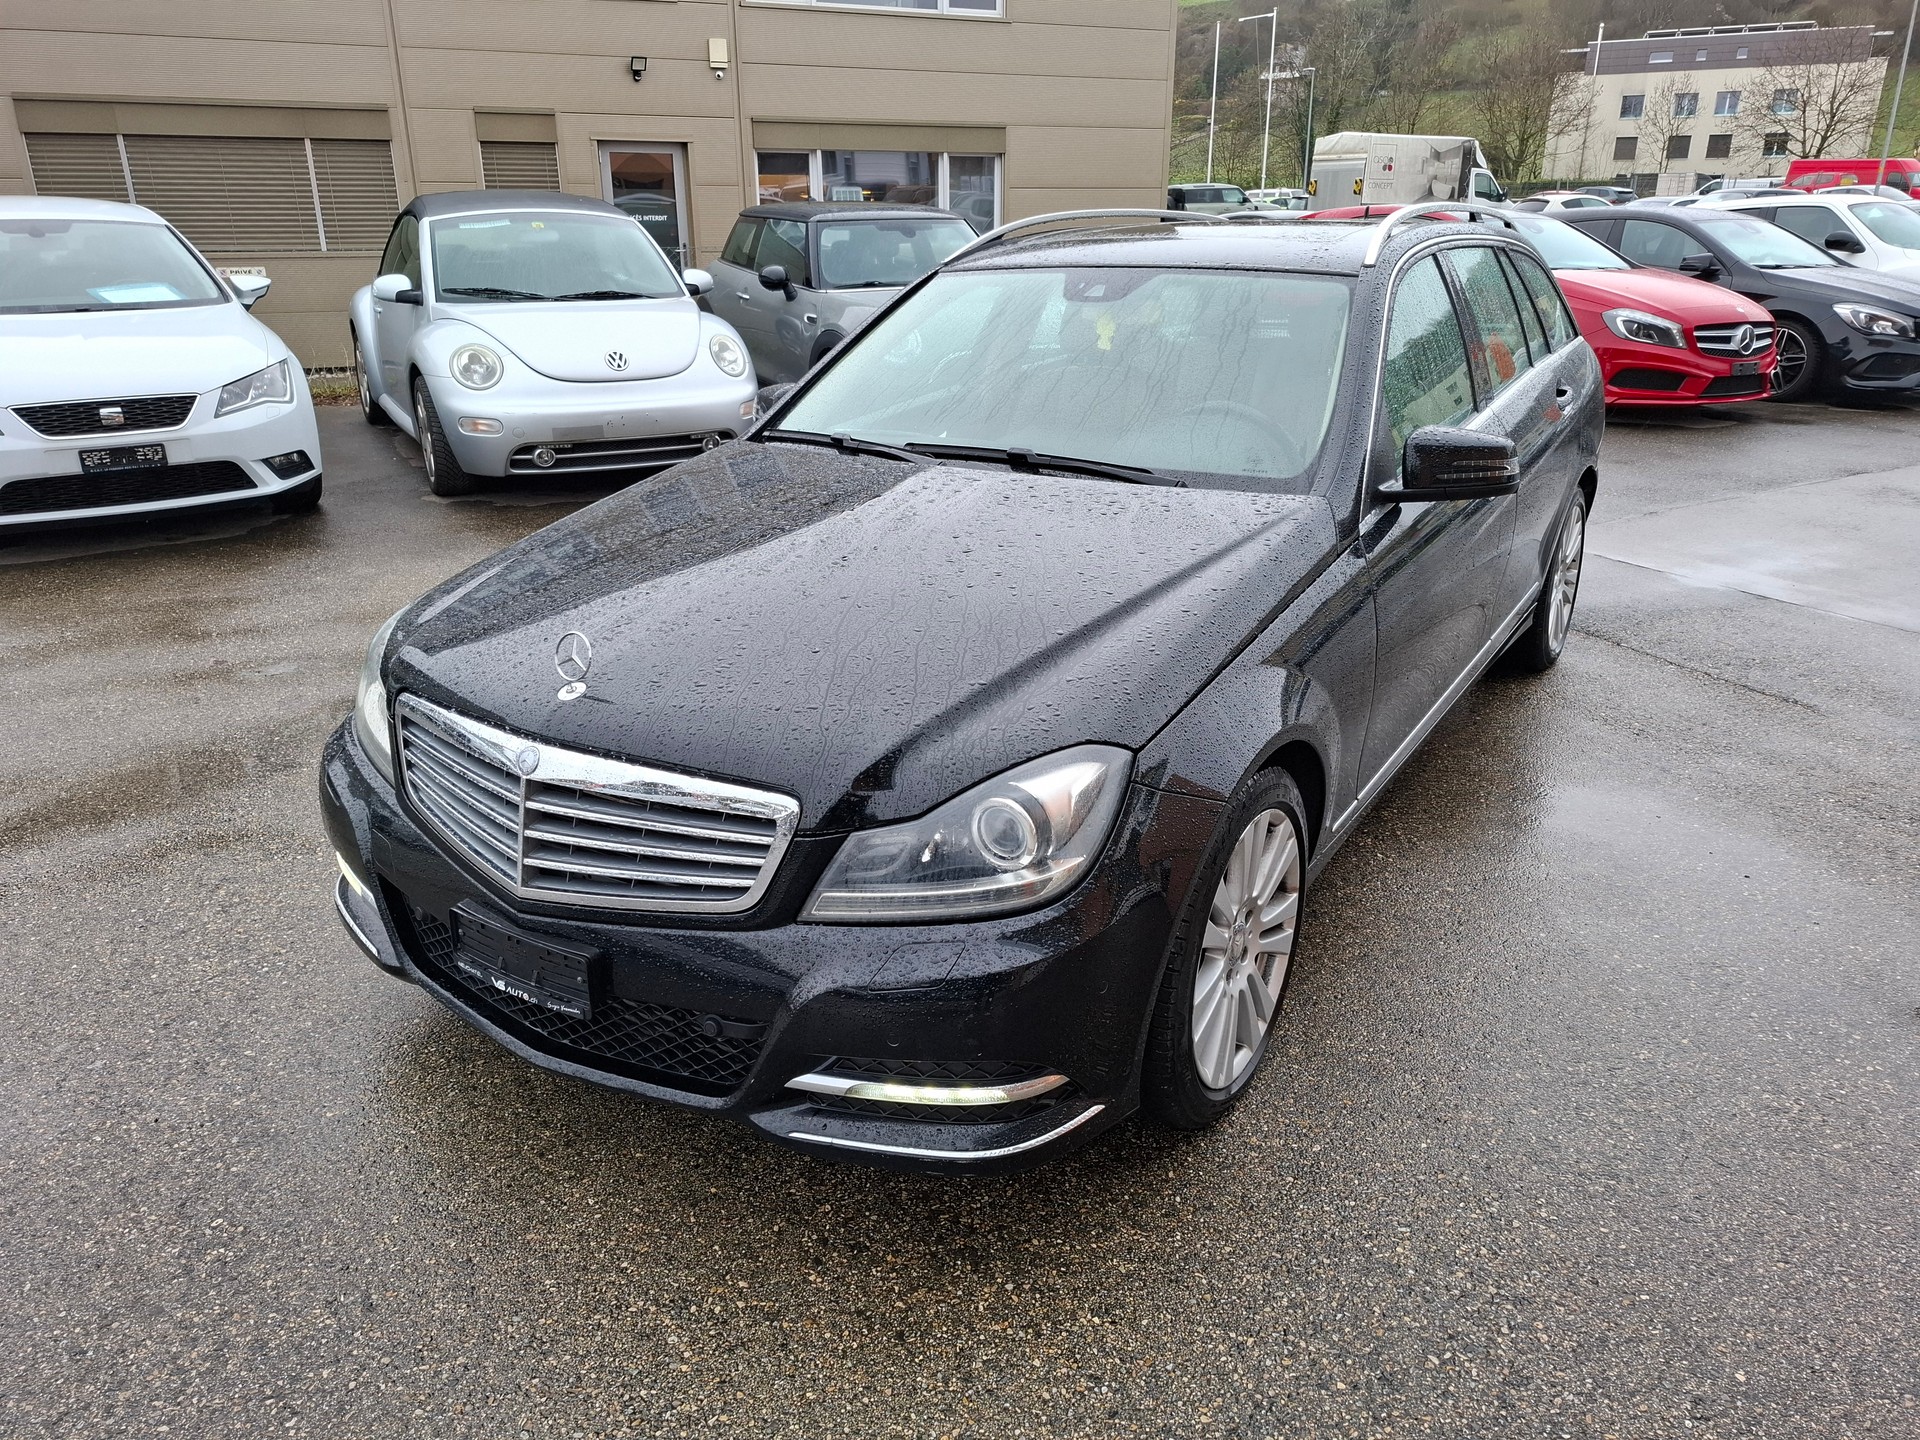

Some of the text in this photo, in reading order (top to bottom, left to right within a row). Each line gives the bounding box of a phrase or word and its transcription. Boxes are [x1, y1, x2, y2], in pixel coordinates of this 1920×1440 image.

[1368, 182, 1394, 190] CONCEPT
[630, 213, 668, 222] CÈS INTERDIT
